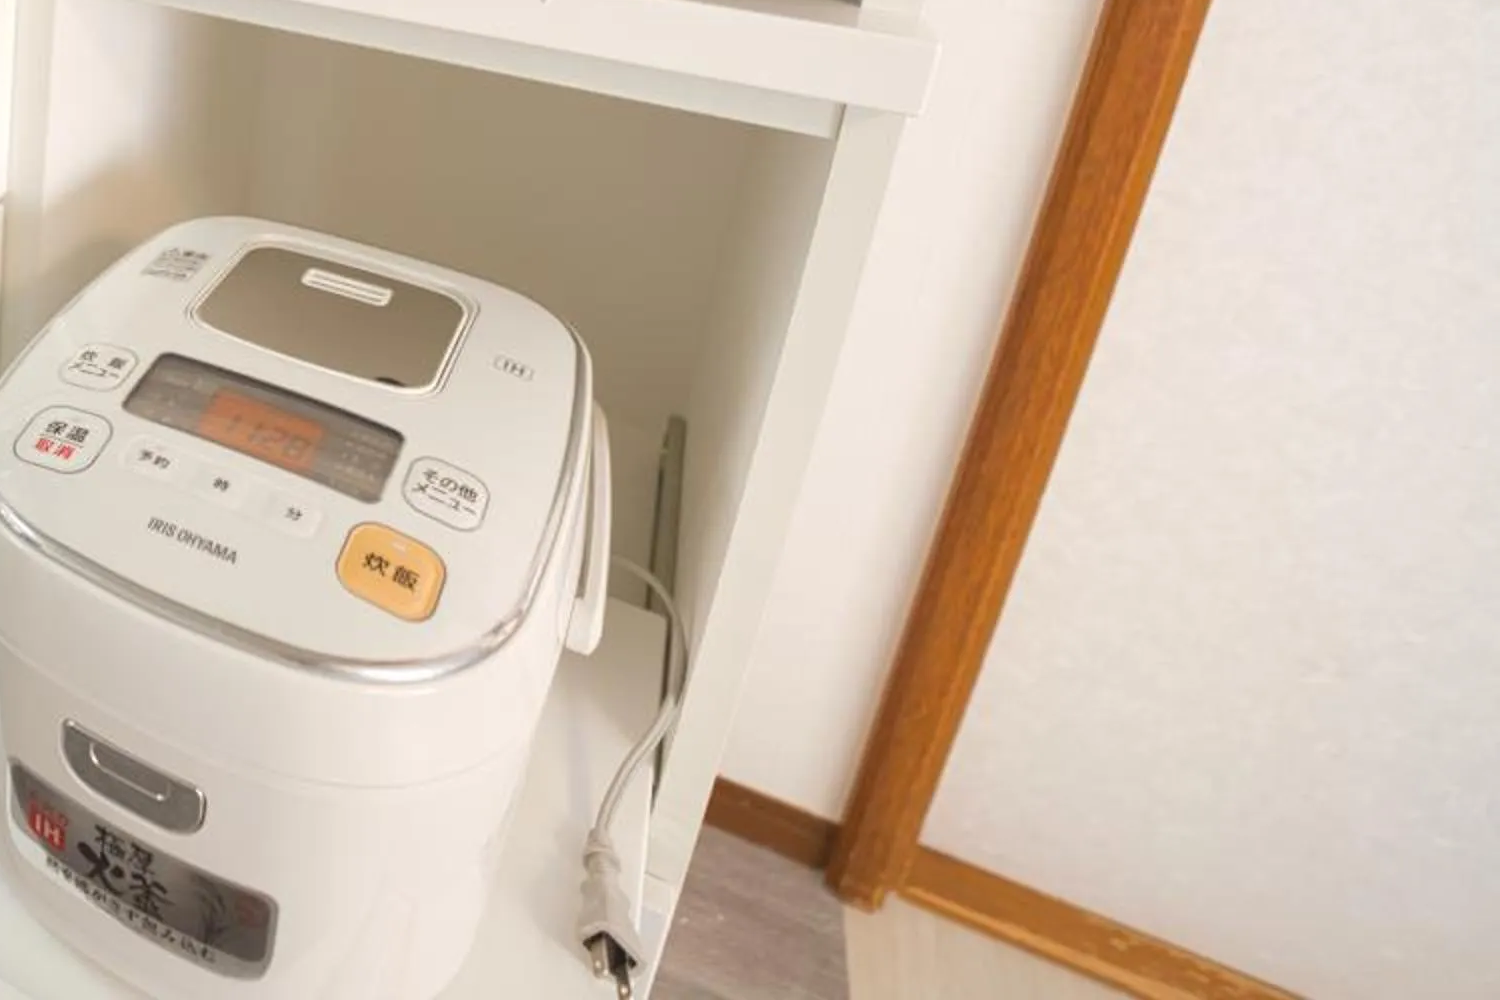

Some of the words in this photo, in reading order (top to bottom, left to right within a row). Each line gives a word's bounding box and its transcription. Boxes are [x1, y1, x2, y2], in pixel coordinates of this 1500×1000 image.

[35, 437, 76, 460] 取消
[45, 421, 89, 443] 保温
[411, 482, 478, 516] メニュー
[423, 468, 479, 503] その他
[147, 516, 176, 538] IRIS
[177, 528, 238, 565] OHYAMA
[361, 551, 421, 596] 炊飯
[34, 812, 63, 848] IH
